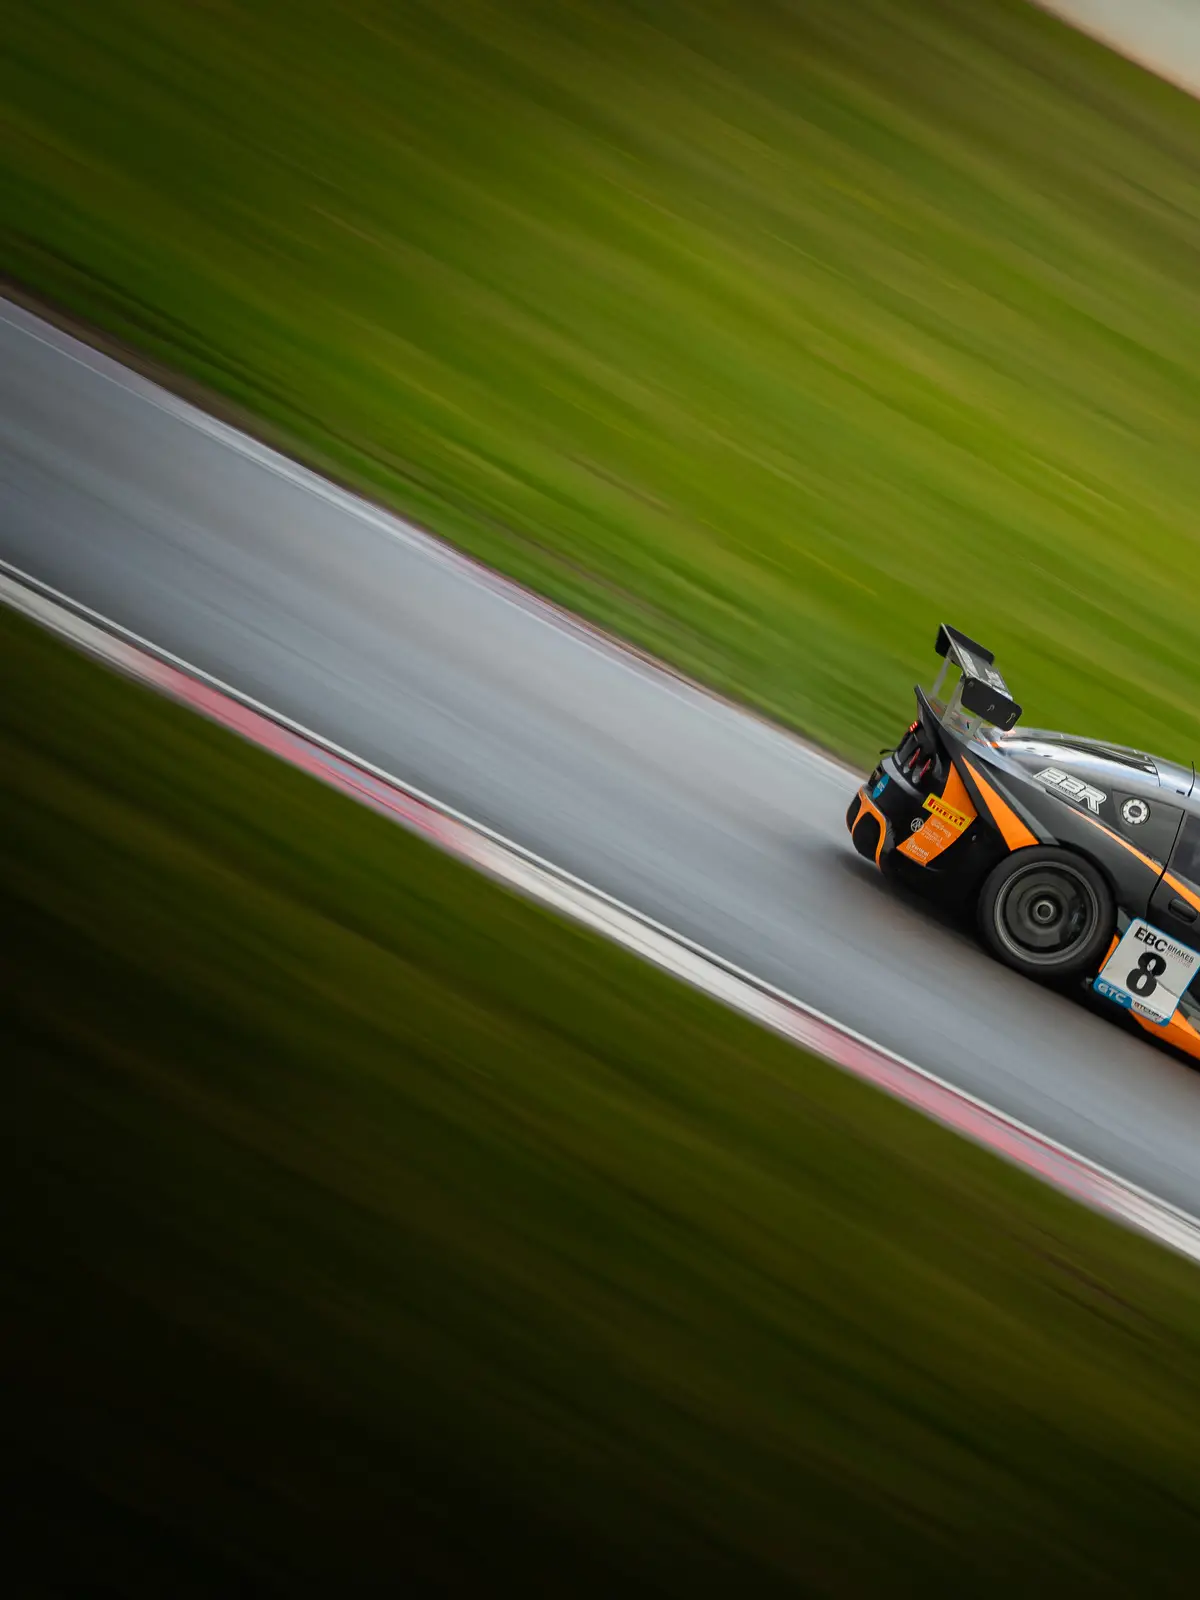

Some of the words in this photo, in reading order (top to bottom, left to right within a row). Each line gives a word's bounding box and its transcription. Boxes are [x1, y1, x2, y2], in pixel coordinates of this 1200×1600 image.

[1033, 767, 1107, 815] BBR
[927, 798, 966, 826] PIRELLI
[1133, 926, 1168, 952] EBC
[1167, 944, 1195, 963] BRAKES
[1126, 951, 1167, 998] 8
[1097, 983, 1126, 1004] GTC
